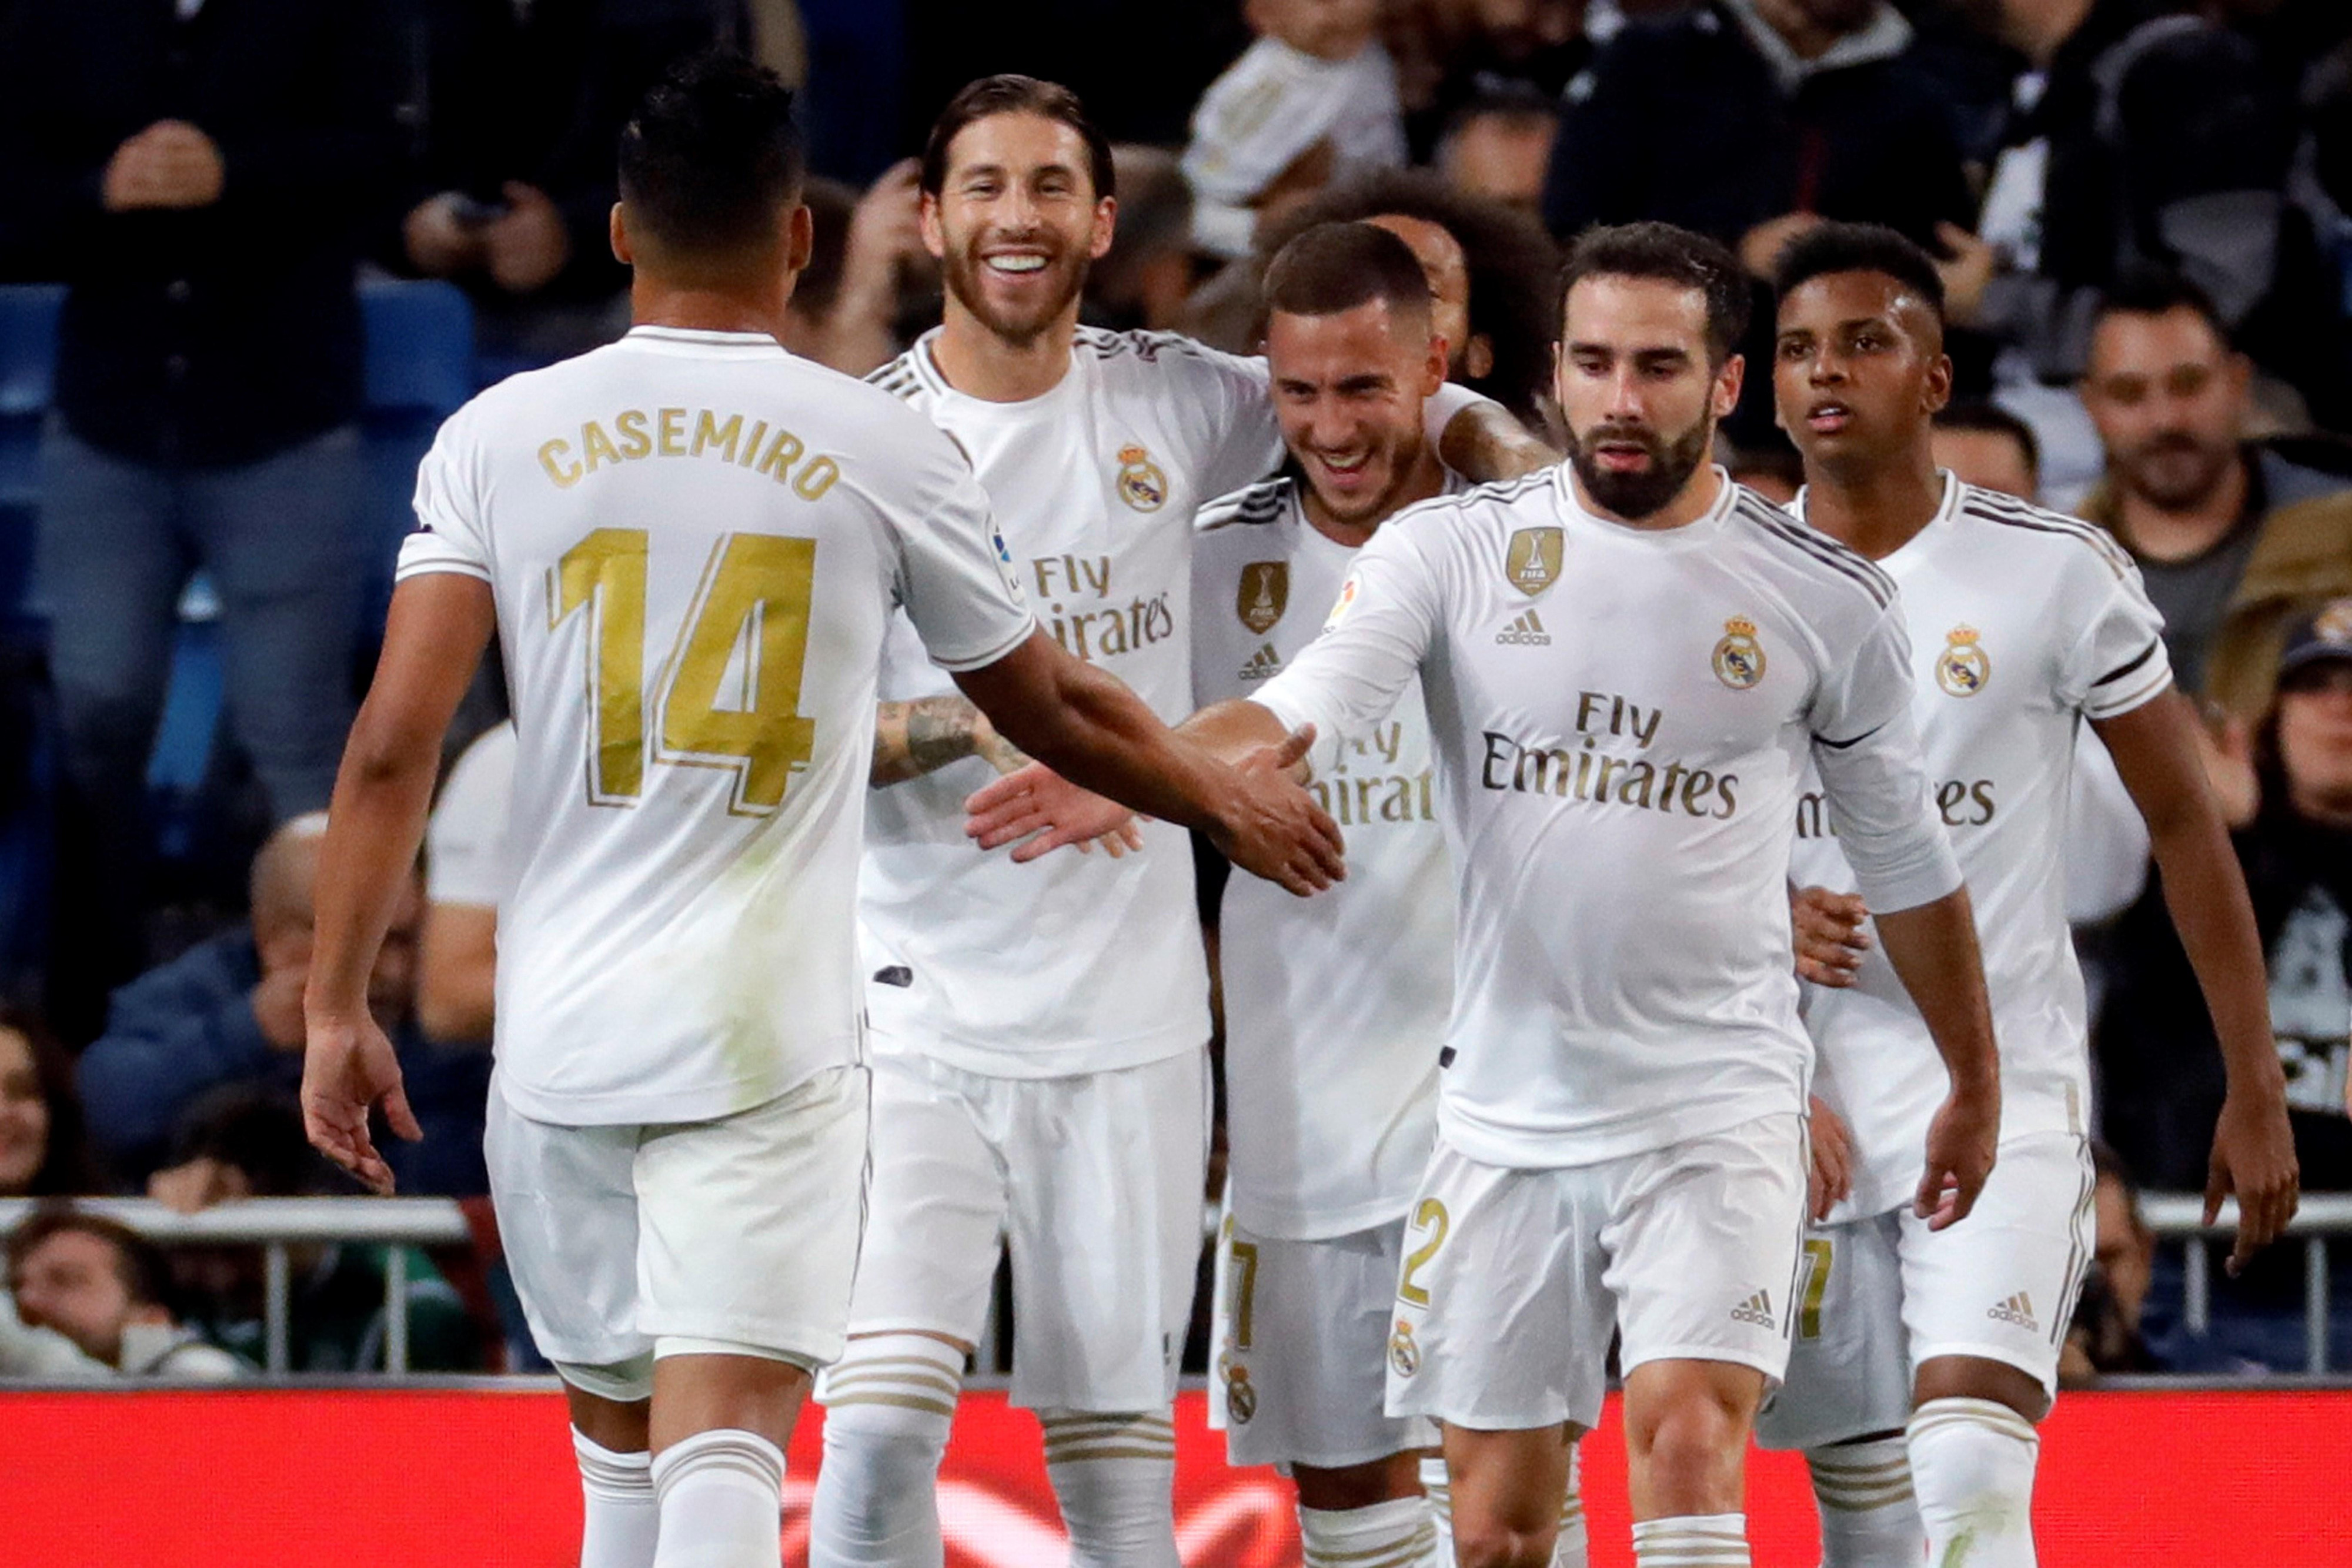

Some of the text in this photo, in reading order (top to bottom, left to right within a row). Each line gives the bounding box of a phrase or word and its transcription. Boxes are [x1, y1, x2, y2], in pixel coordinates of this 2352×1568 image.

[537, 408, 841, 502] CASEMIRO
[1033, 554, 1110, 599] Fly
[1051, 591, 1173, 660] irates
[1496, 631, 1551, 646] adidas
[545, 528, 818, 818] 14
[1576, 690, 1662, 748] Fly
[1482, 731, 1739, 820] Emirates
[1396, 1197, 1449, 1310] 2
[1730, 1309, 1775, 1330] adidas
[1987, 1308, 2038, 1333] adidas
